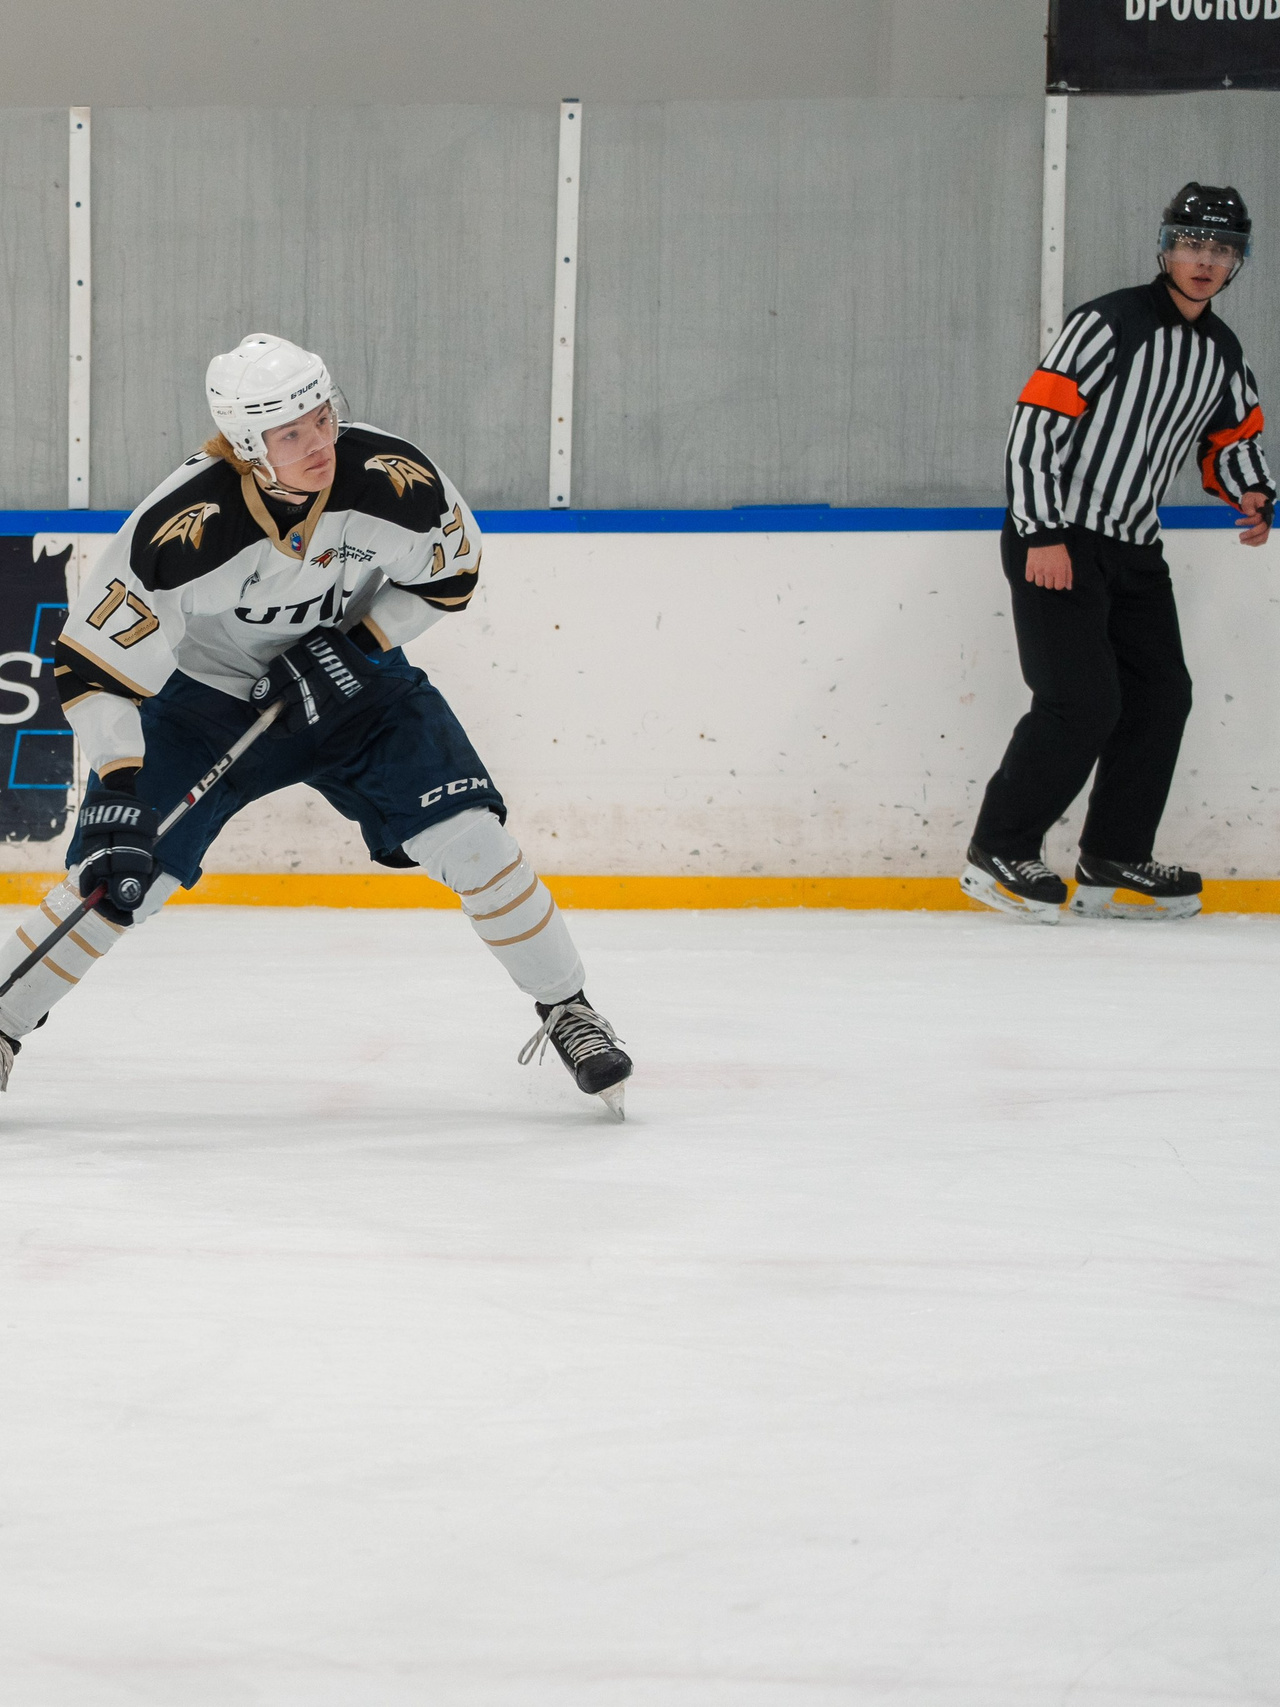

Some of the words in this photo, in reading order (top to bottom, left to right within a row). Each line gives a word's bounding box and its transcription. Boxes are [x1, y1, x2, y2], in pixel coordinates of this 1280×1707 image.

[85, 577, 160, 650] 17
[418, 777, 489, 808] CCM
[991, 856, 1018, 882] CCM
[1121, 870, 1156, 888] CCM
